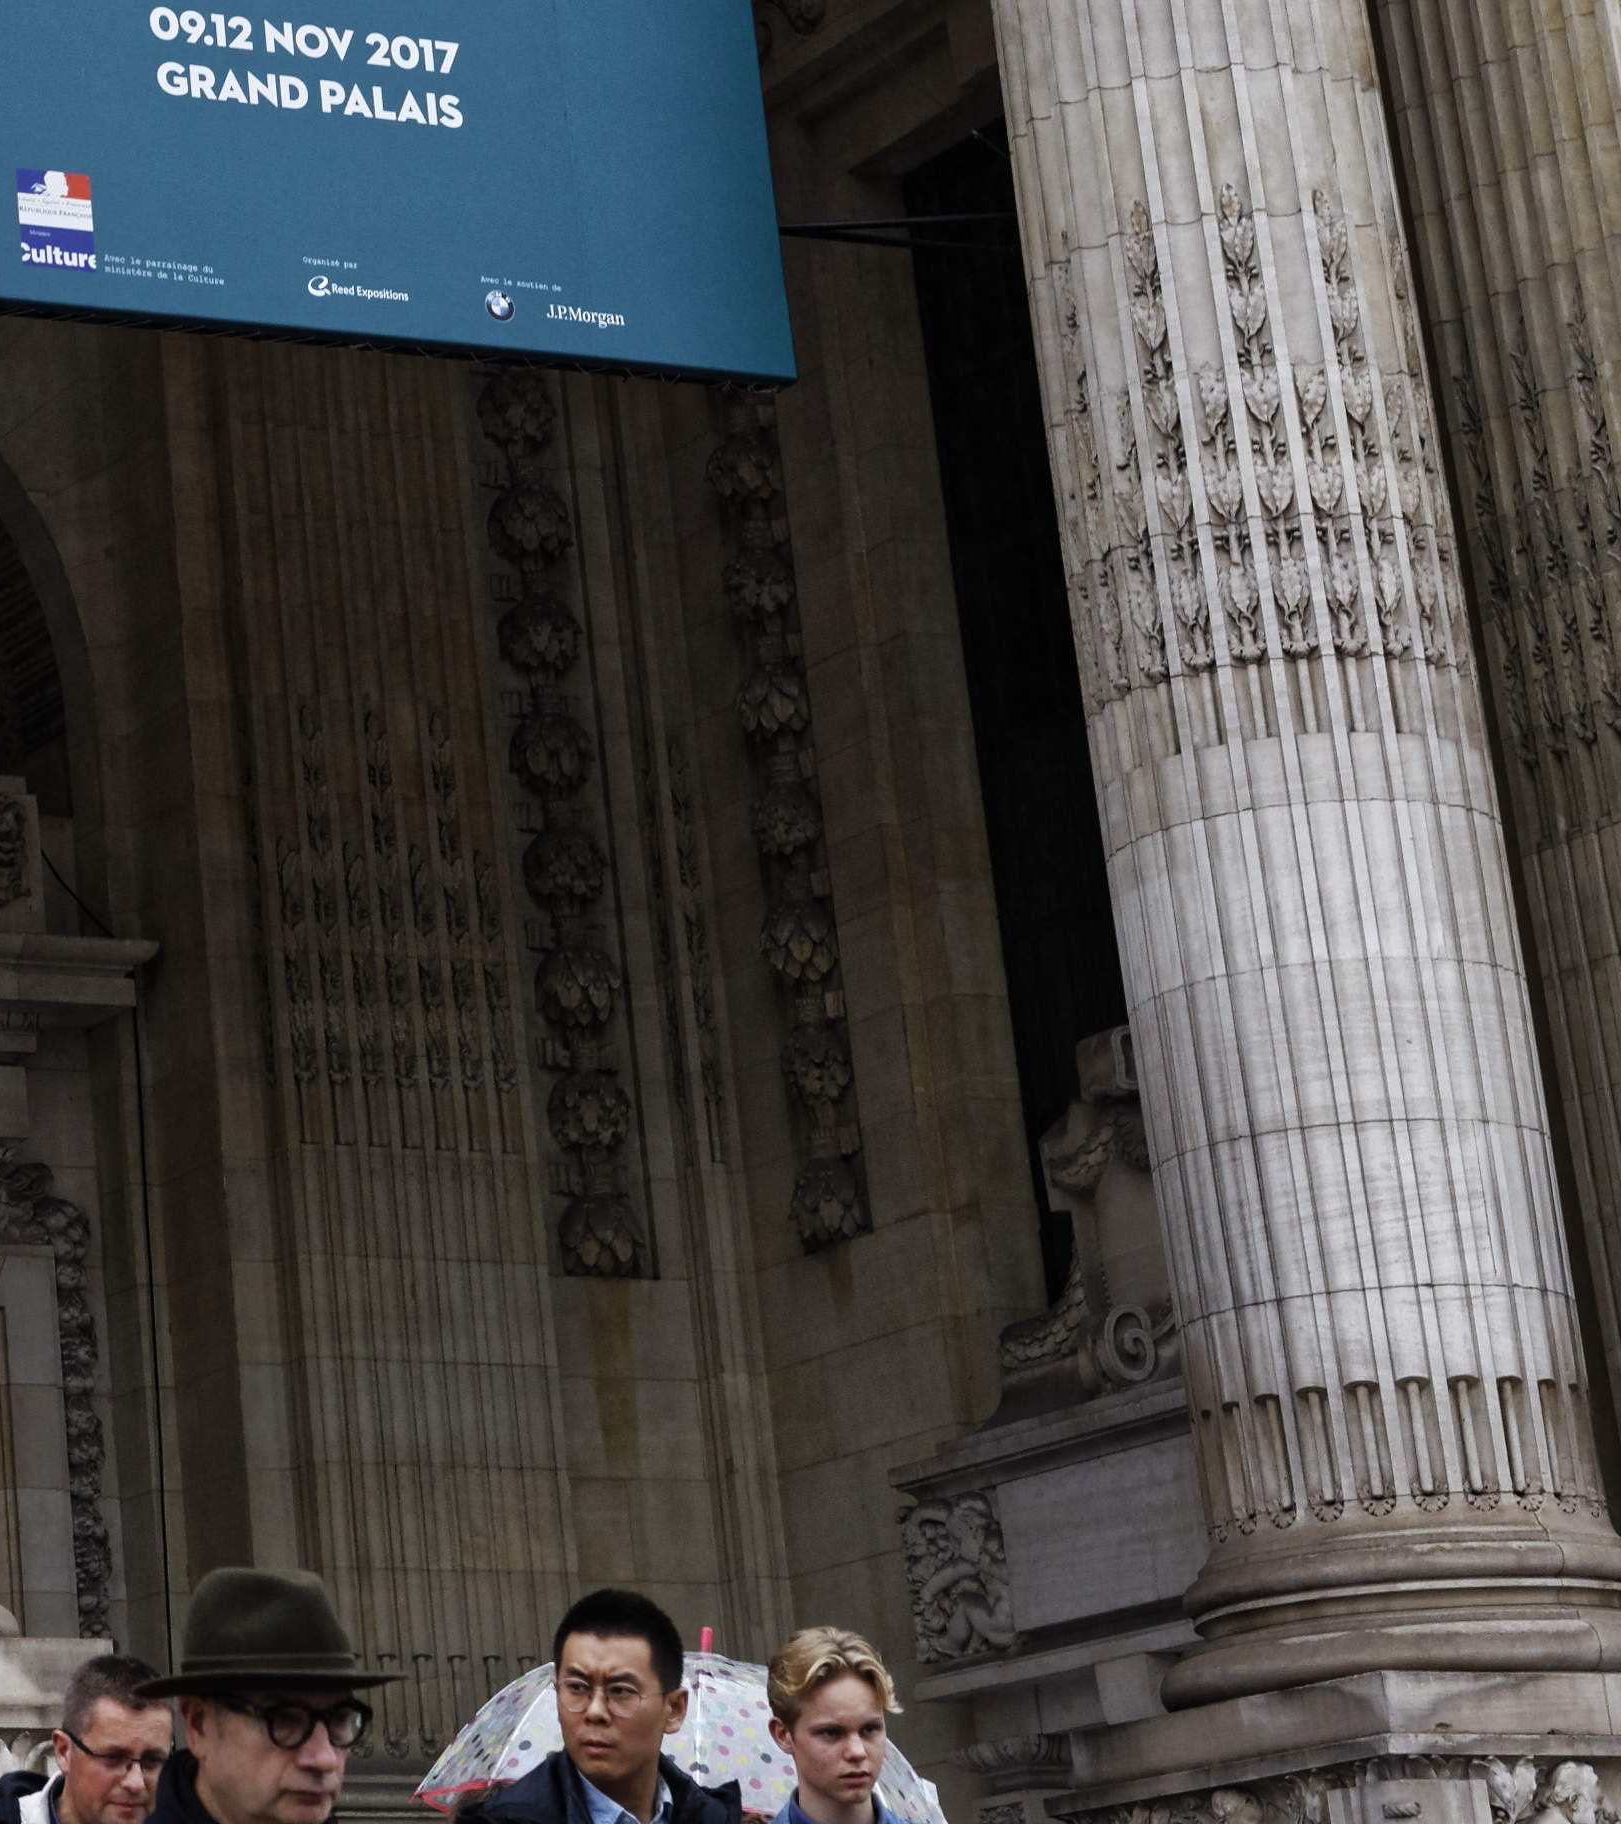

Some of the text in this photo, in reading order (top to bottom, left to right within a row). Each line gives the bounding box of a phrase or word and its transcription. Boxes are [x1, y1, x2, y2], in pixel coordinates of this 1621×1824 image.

[149, 6, 459, 74] 09.12 NOV 2017
[157, 61, 463, 128] GRAND PALAIS
[104, 254, 213, 274] Avec le parrainage du
[344, 261, 357, 270] par
[157, 270, 168, 279] de
[173, 272, 183, 281] la
[188, 274, 225, 285] Culture
[480, 275, 562, 292] Avec le soutien de
[331, 283, 409, 302] Reed Expositions
[546, 303, 626, 329] J.P.Morgan
